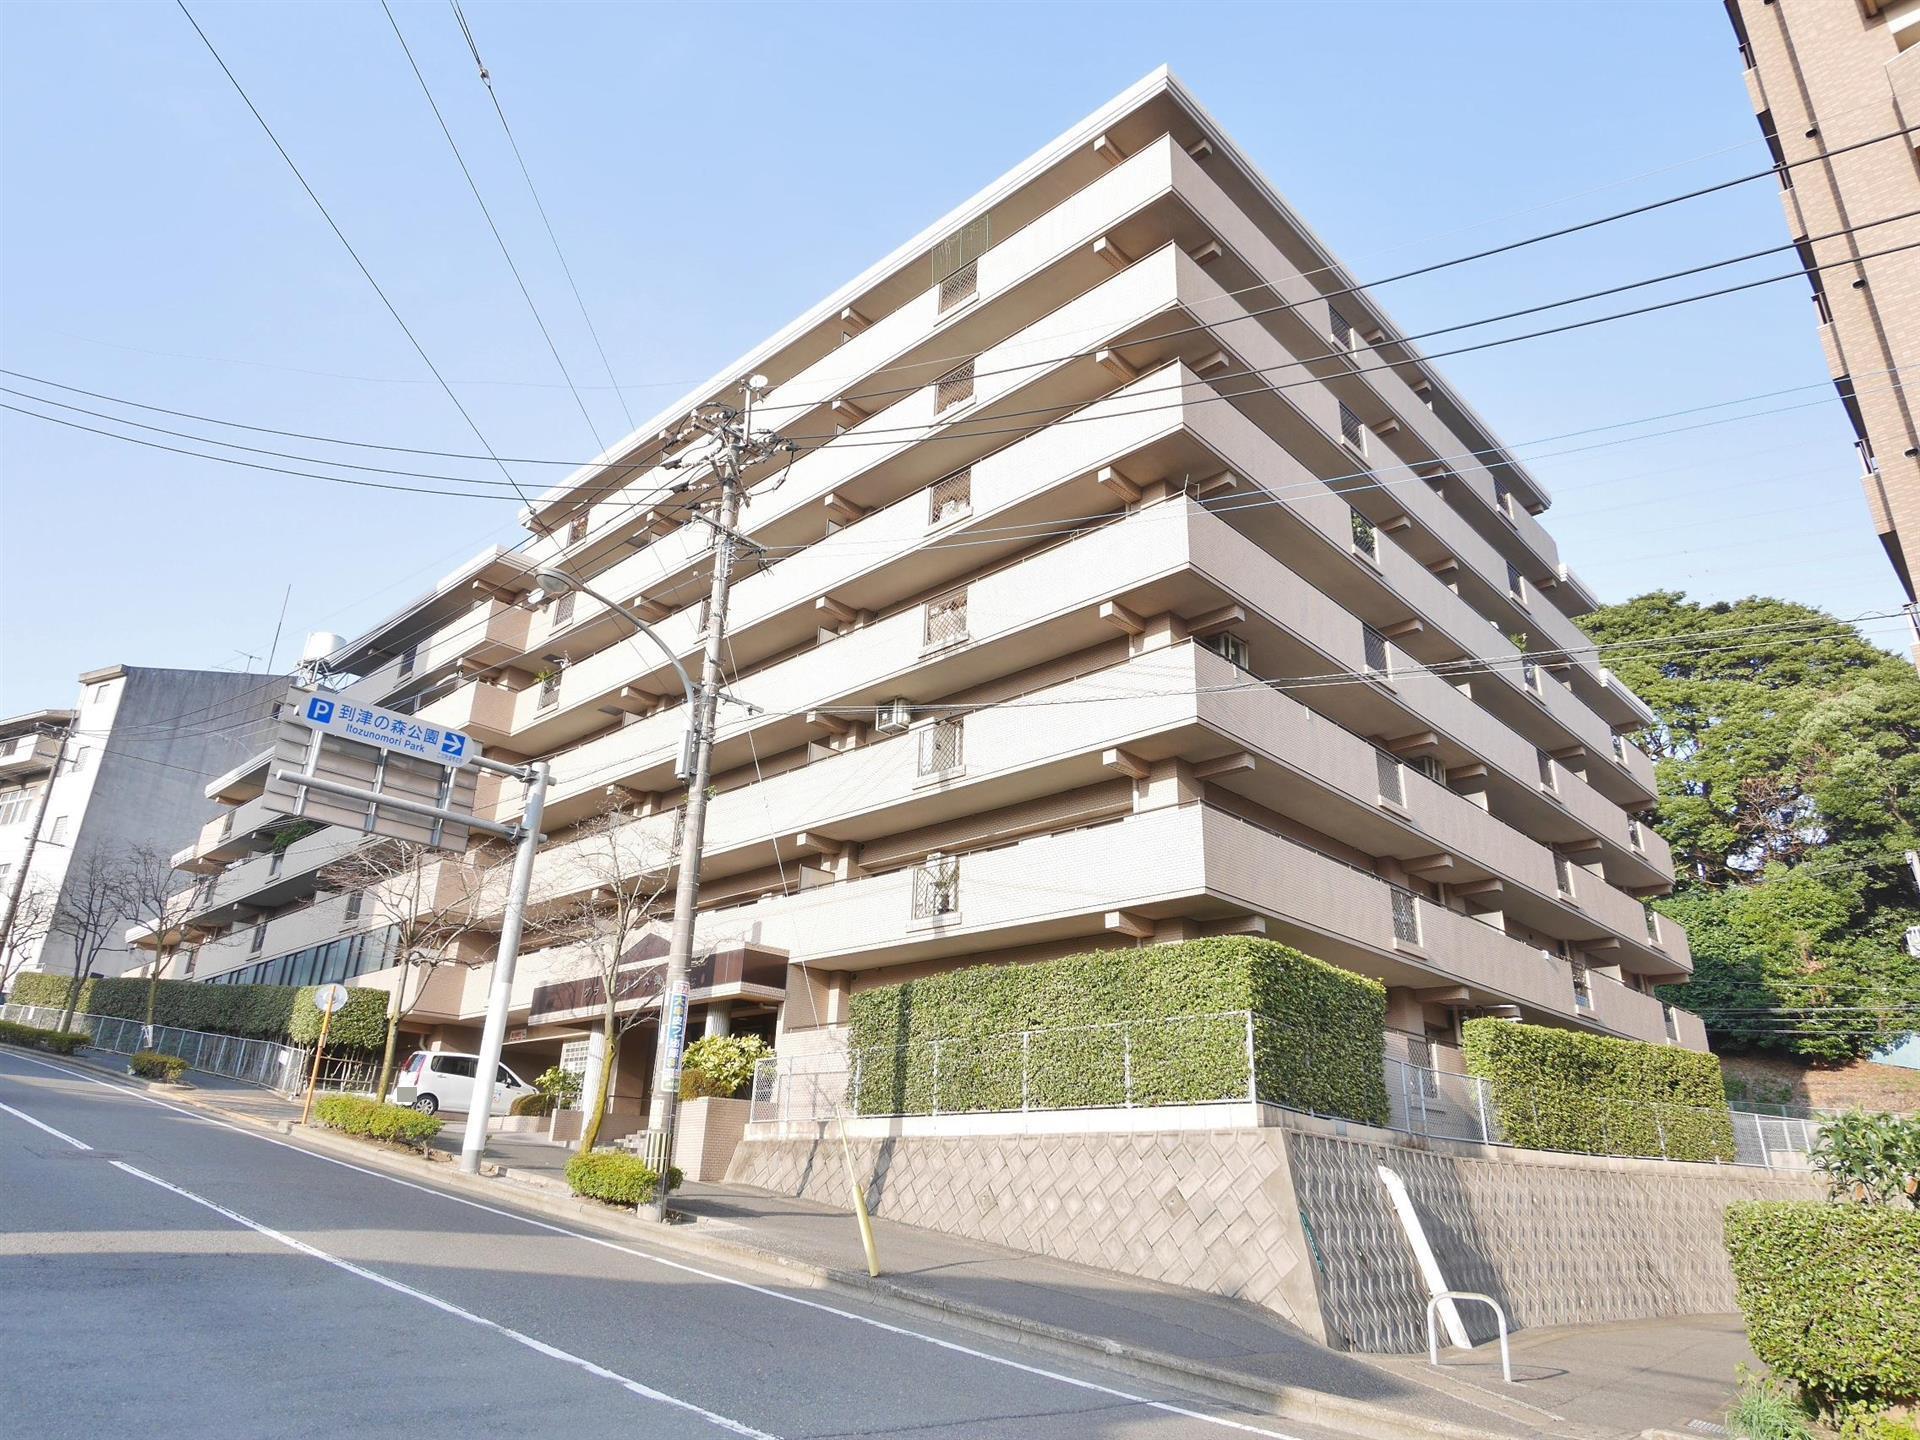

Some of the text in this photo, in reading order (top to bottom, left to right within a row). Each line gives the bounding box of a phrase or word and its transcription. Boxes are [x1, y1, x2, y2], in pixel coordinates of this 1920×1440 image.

[313, 702, 329, 719] P
[339, 704, 439, 745] 到津の森公園
[345, 723, 425, 753] Itozunomori Park
